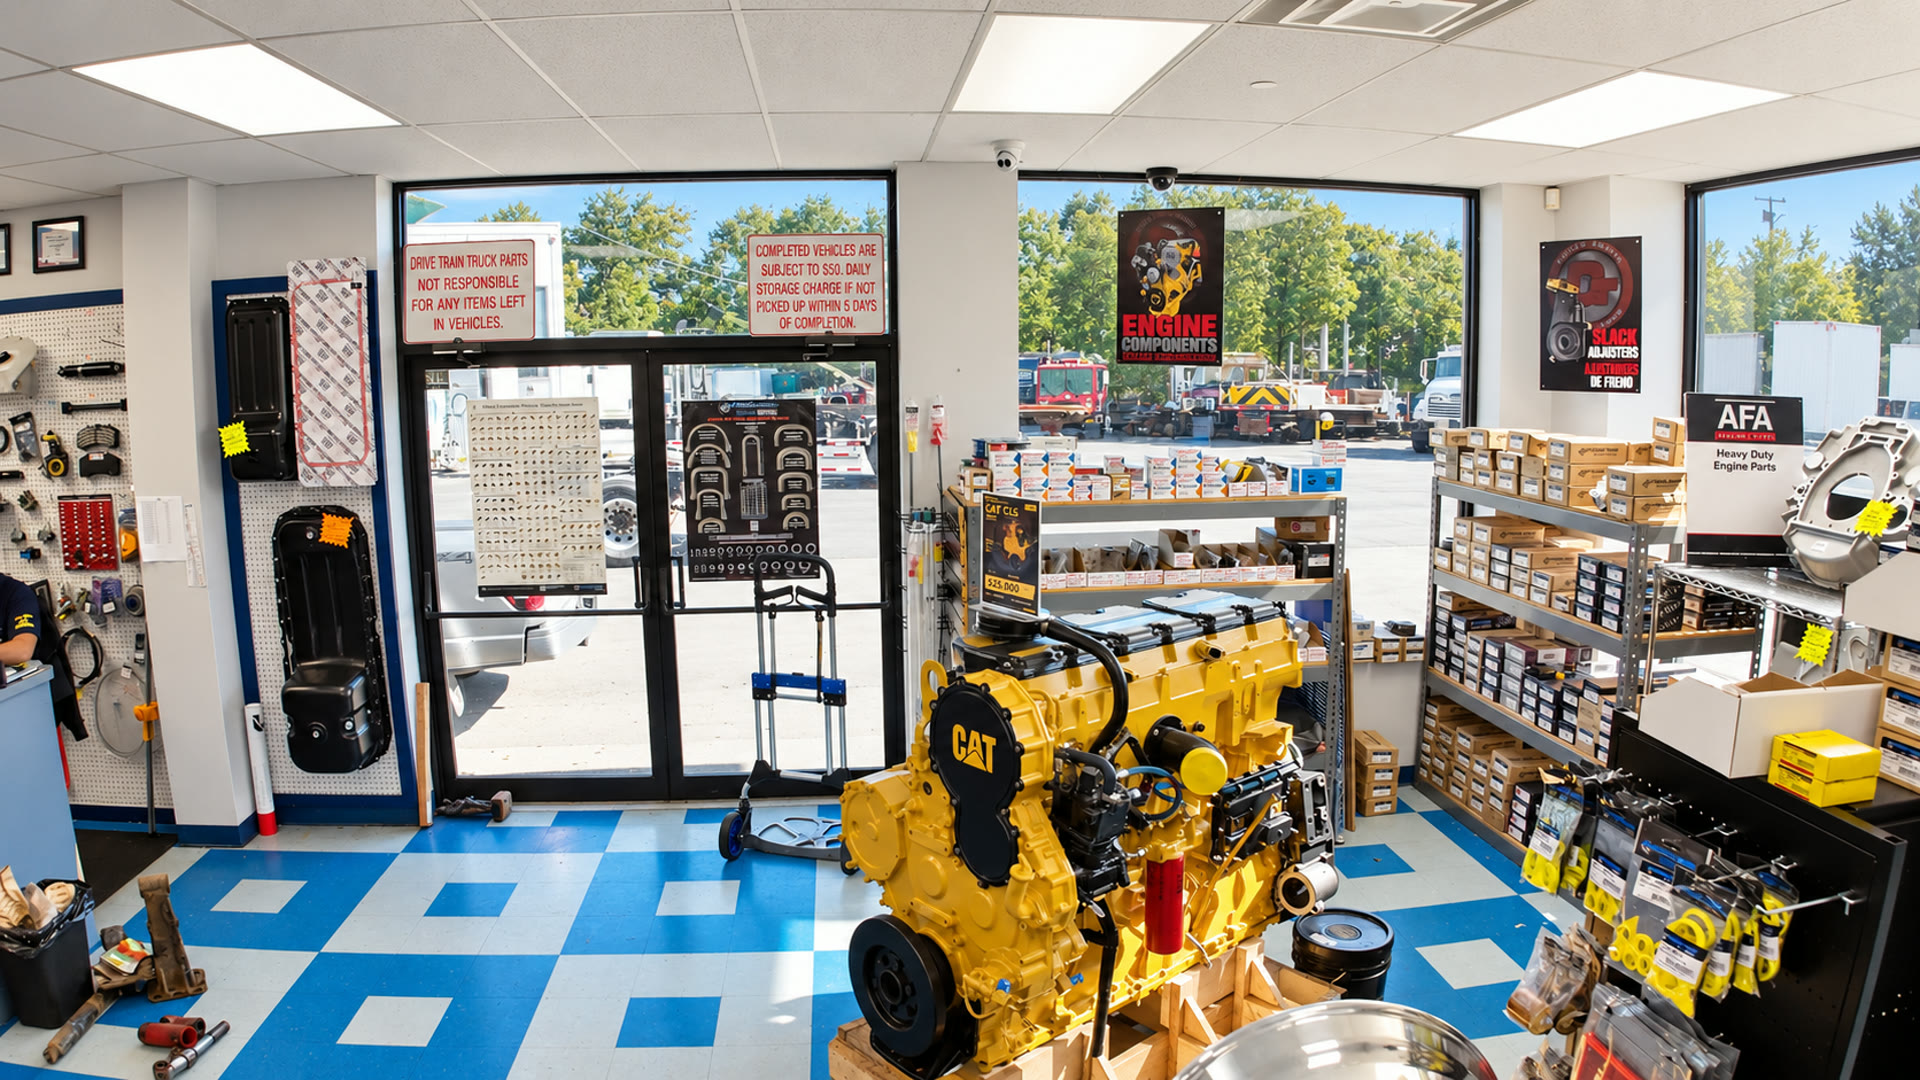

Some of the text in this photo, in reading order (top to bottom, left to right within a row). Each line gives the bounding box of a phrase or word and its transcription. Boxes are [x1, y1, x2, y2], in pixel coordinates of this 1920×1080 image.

[756, 244, 877, 257] COMPLETED VEHICLES ARE
[410, 253, 528, 270] DRIVE TRAIN TRUCK PARTS
[761, 263, 804, 276] SUBJECT
[807, 263, 819, 276] TO
[846, 263, 871, 275] DAILY
[418, 275, 519, 291] NOT RESPONSIBLE
[756, 282, 875, 295] STORAGE CHARGE IF NOT
[411, 295, 526, 312] FOR ANY ITEMS LEFT
[756, 300, 877, 313] PICKED UP WITHIN 5 DAYS
[433, 316, 504, 331] IN VEHICLES.
[780, 317, 856, 329] OF COMPLETION.
[1122, 314, 1217, 337] ENGINE
[1592, 328, 1638, 345] SLACK
[1121, 337, 1218, 353] COMPONENTS
[1588, 346, 1639, 359] ADJUSTERS
[1590, 375, 1602, 388] DE
[1718, 404, 1773, 431] AFA
[1717, 449, 1774, 461] Heavy Duty
[1714, 461, 1776, 472] Engine Parts
[952, 723, 996, 773] CAT
